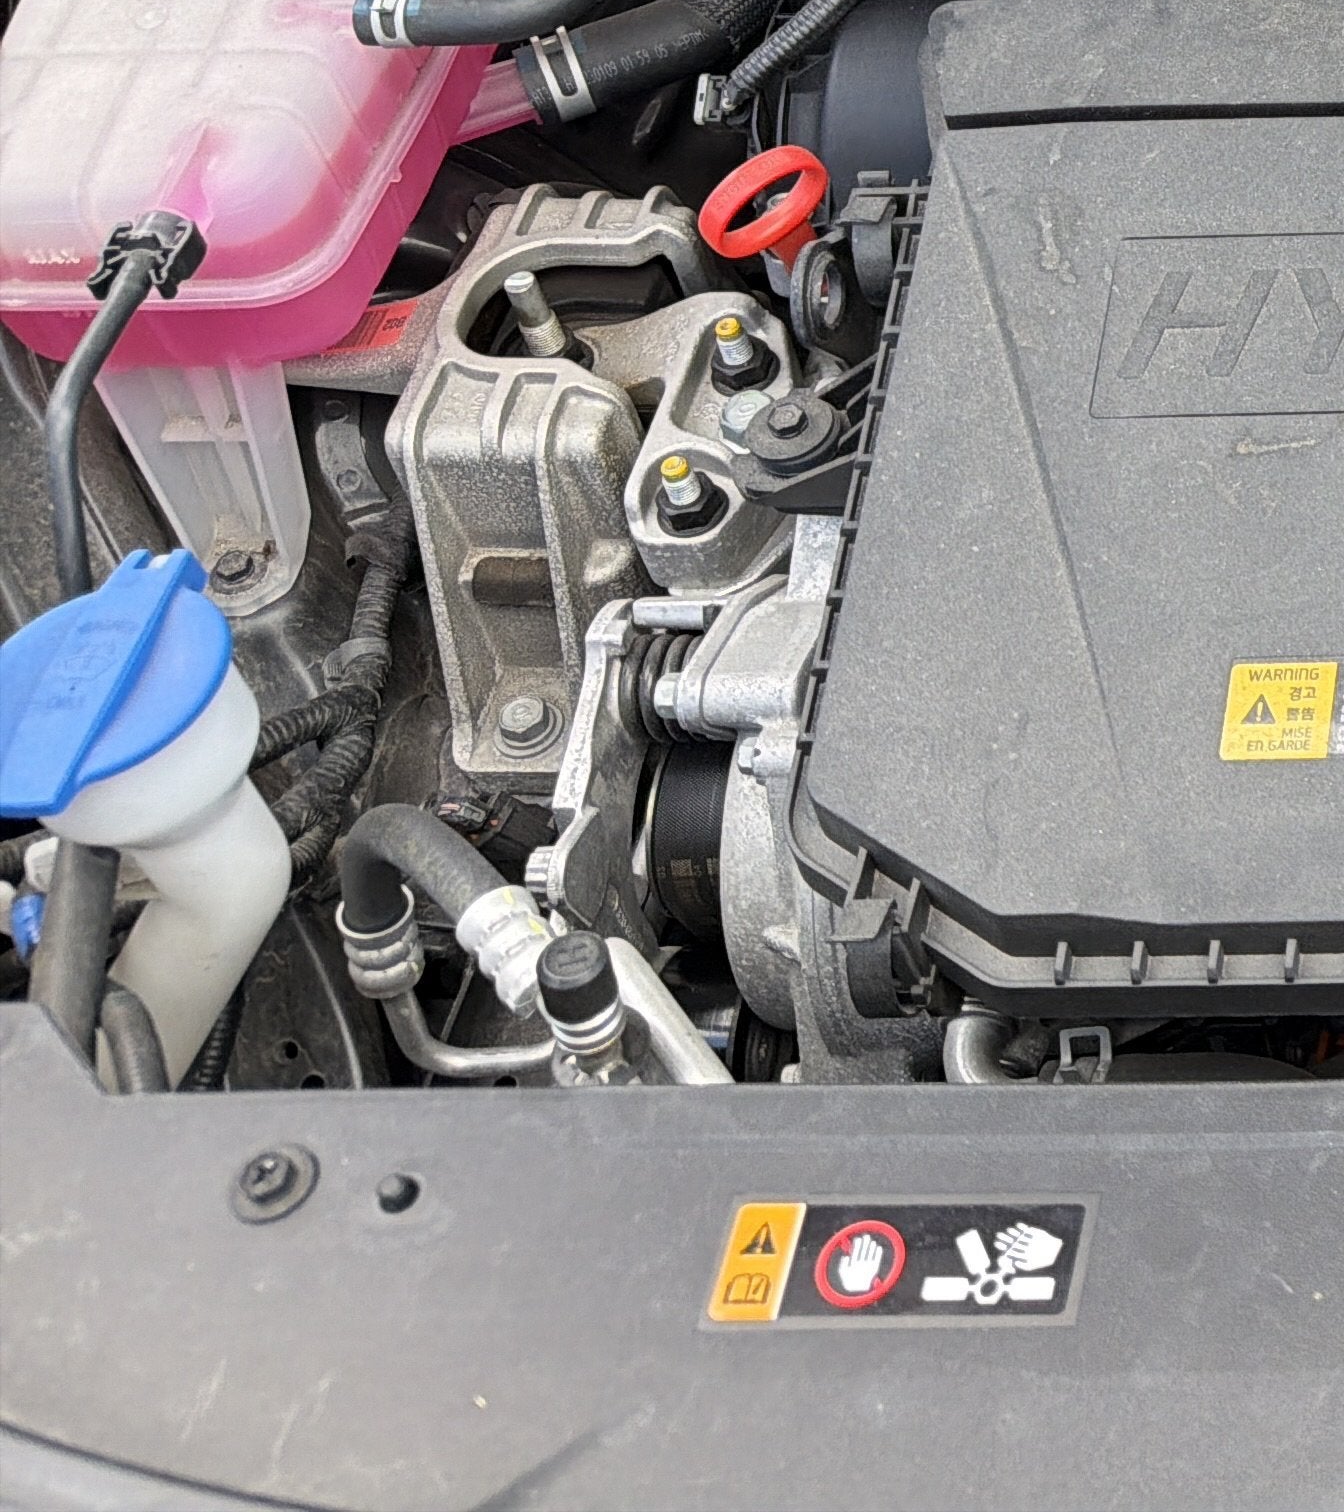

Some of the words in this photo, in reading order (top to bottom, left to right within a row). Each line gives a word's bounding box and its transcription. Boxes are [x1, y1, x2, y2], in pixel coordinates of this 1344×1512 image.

[1248, 667, 1320, 682] WARNING
[1288, 686, 1317, 701] 경고
[1281, 727, 1313, 739] MISE
[1246, 741, 1264, 752] EN
[1268, 739, 1312, 751] GARDE
